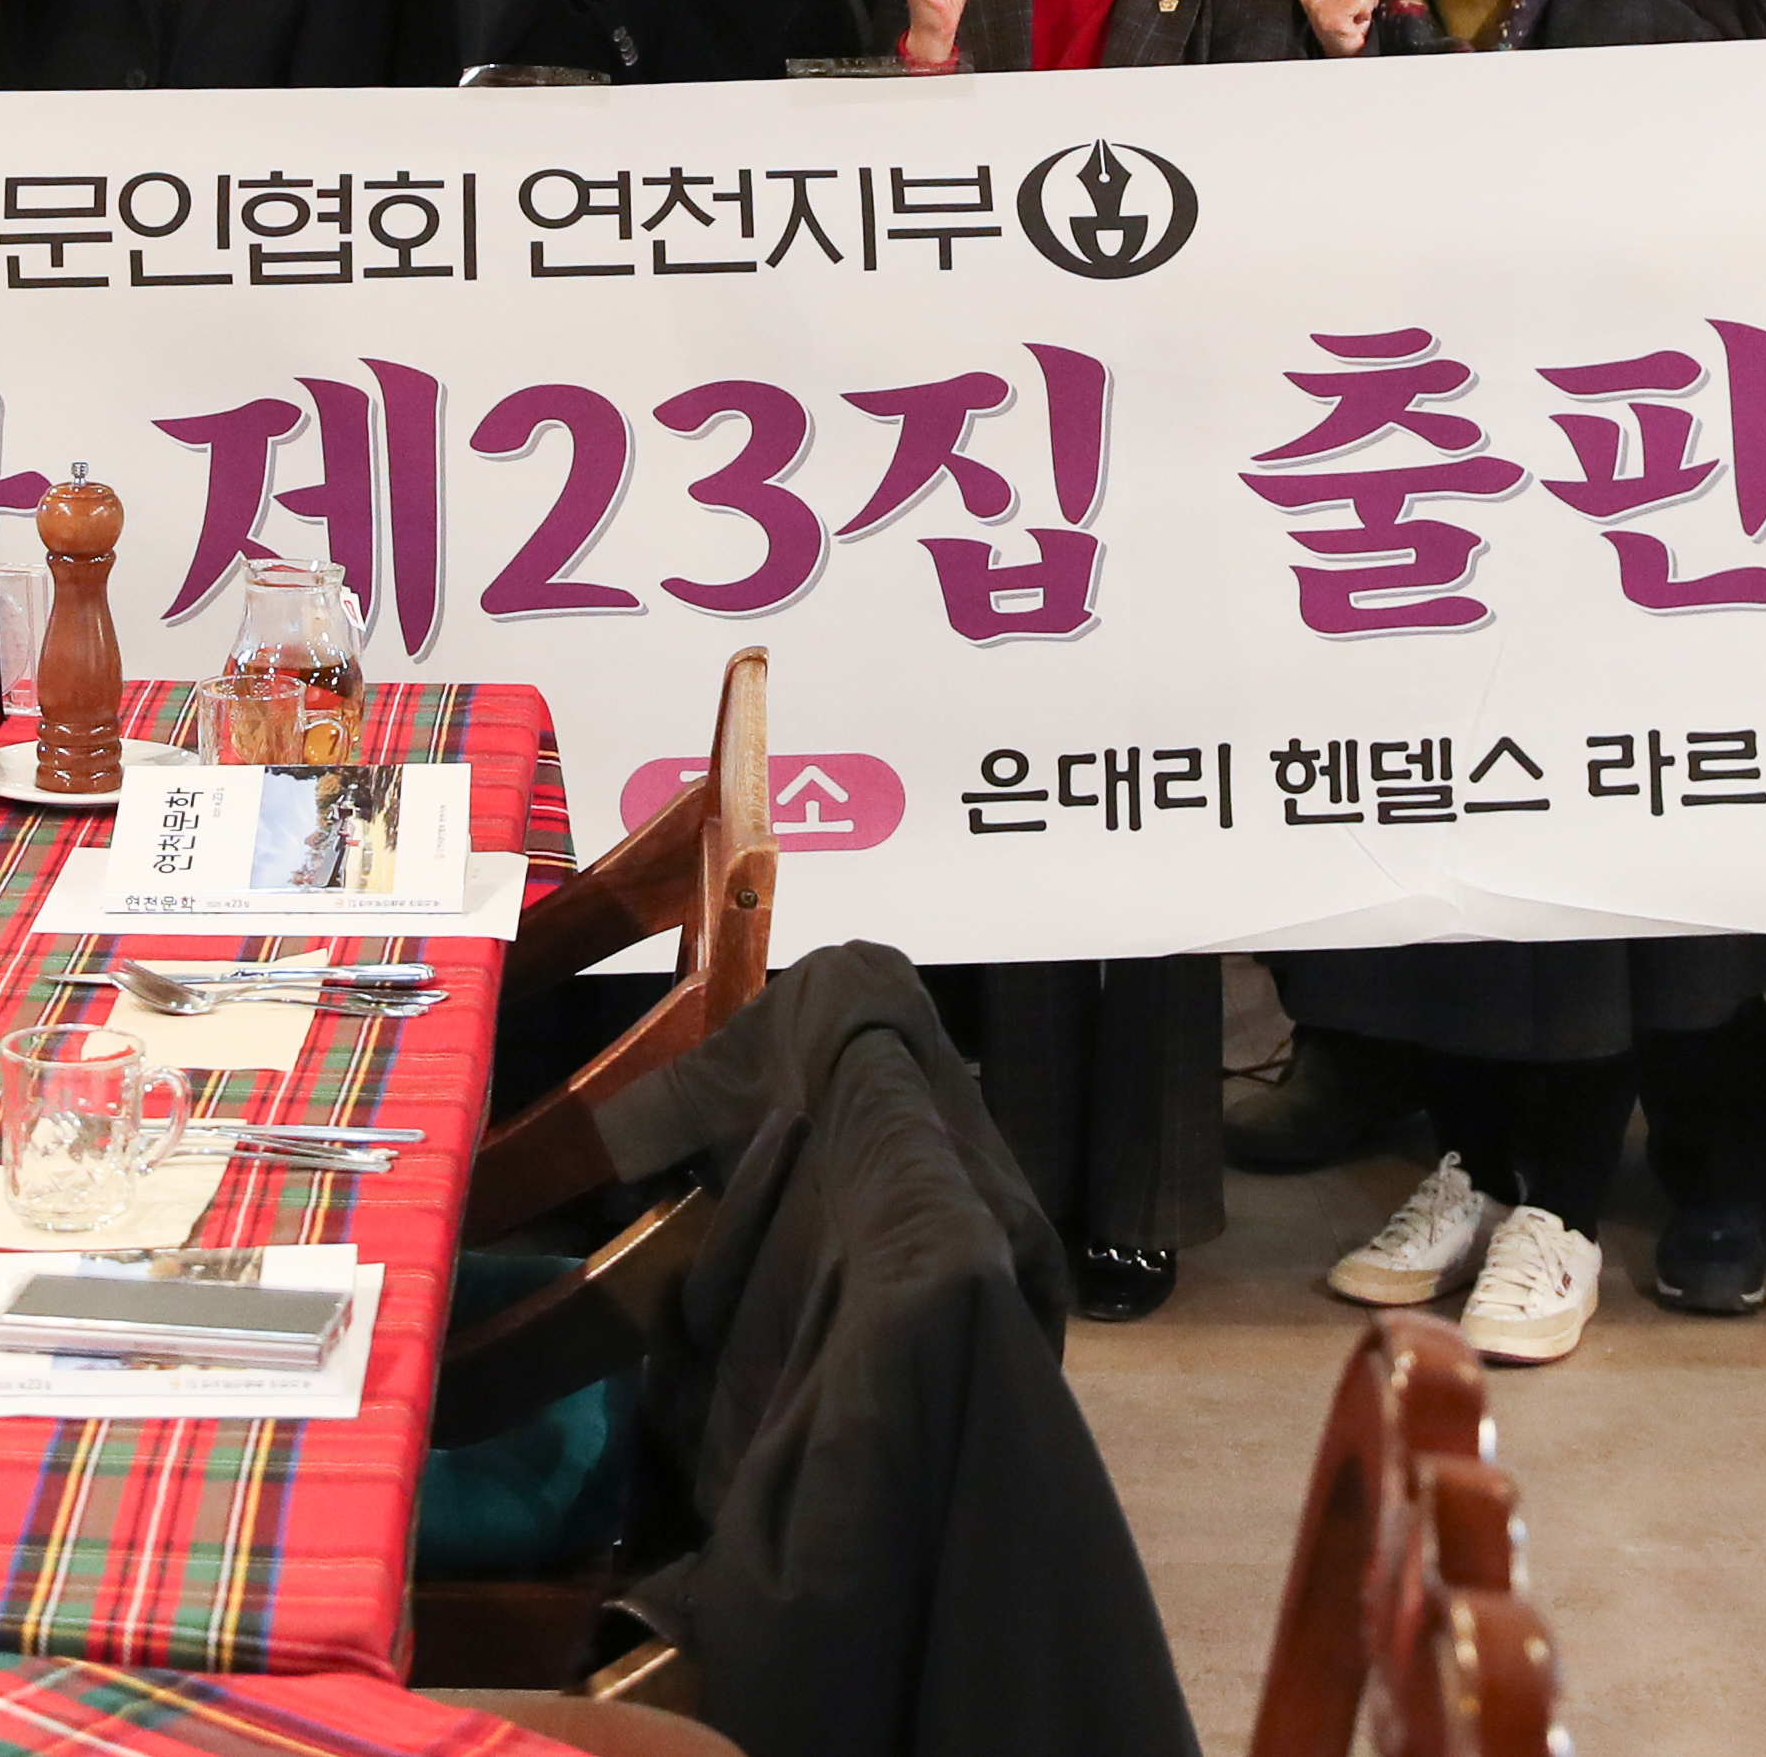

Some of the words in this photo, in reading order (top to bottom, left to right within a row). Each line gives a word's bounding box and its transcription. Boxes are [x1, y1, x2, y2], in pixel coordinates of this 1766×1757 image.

[518, 164, 1003, 278] 연천지부
[152, 342, 1109, 658] 제23집
[152, 787, 204, 874] 연천문학
[960, 742, 1234, 835] 은대리
[1268, 735, 1552, 827] 헨델스
[125, 895, 196, 912] 연천문학
